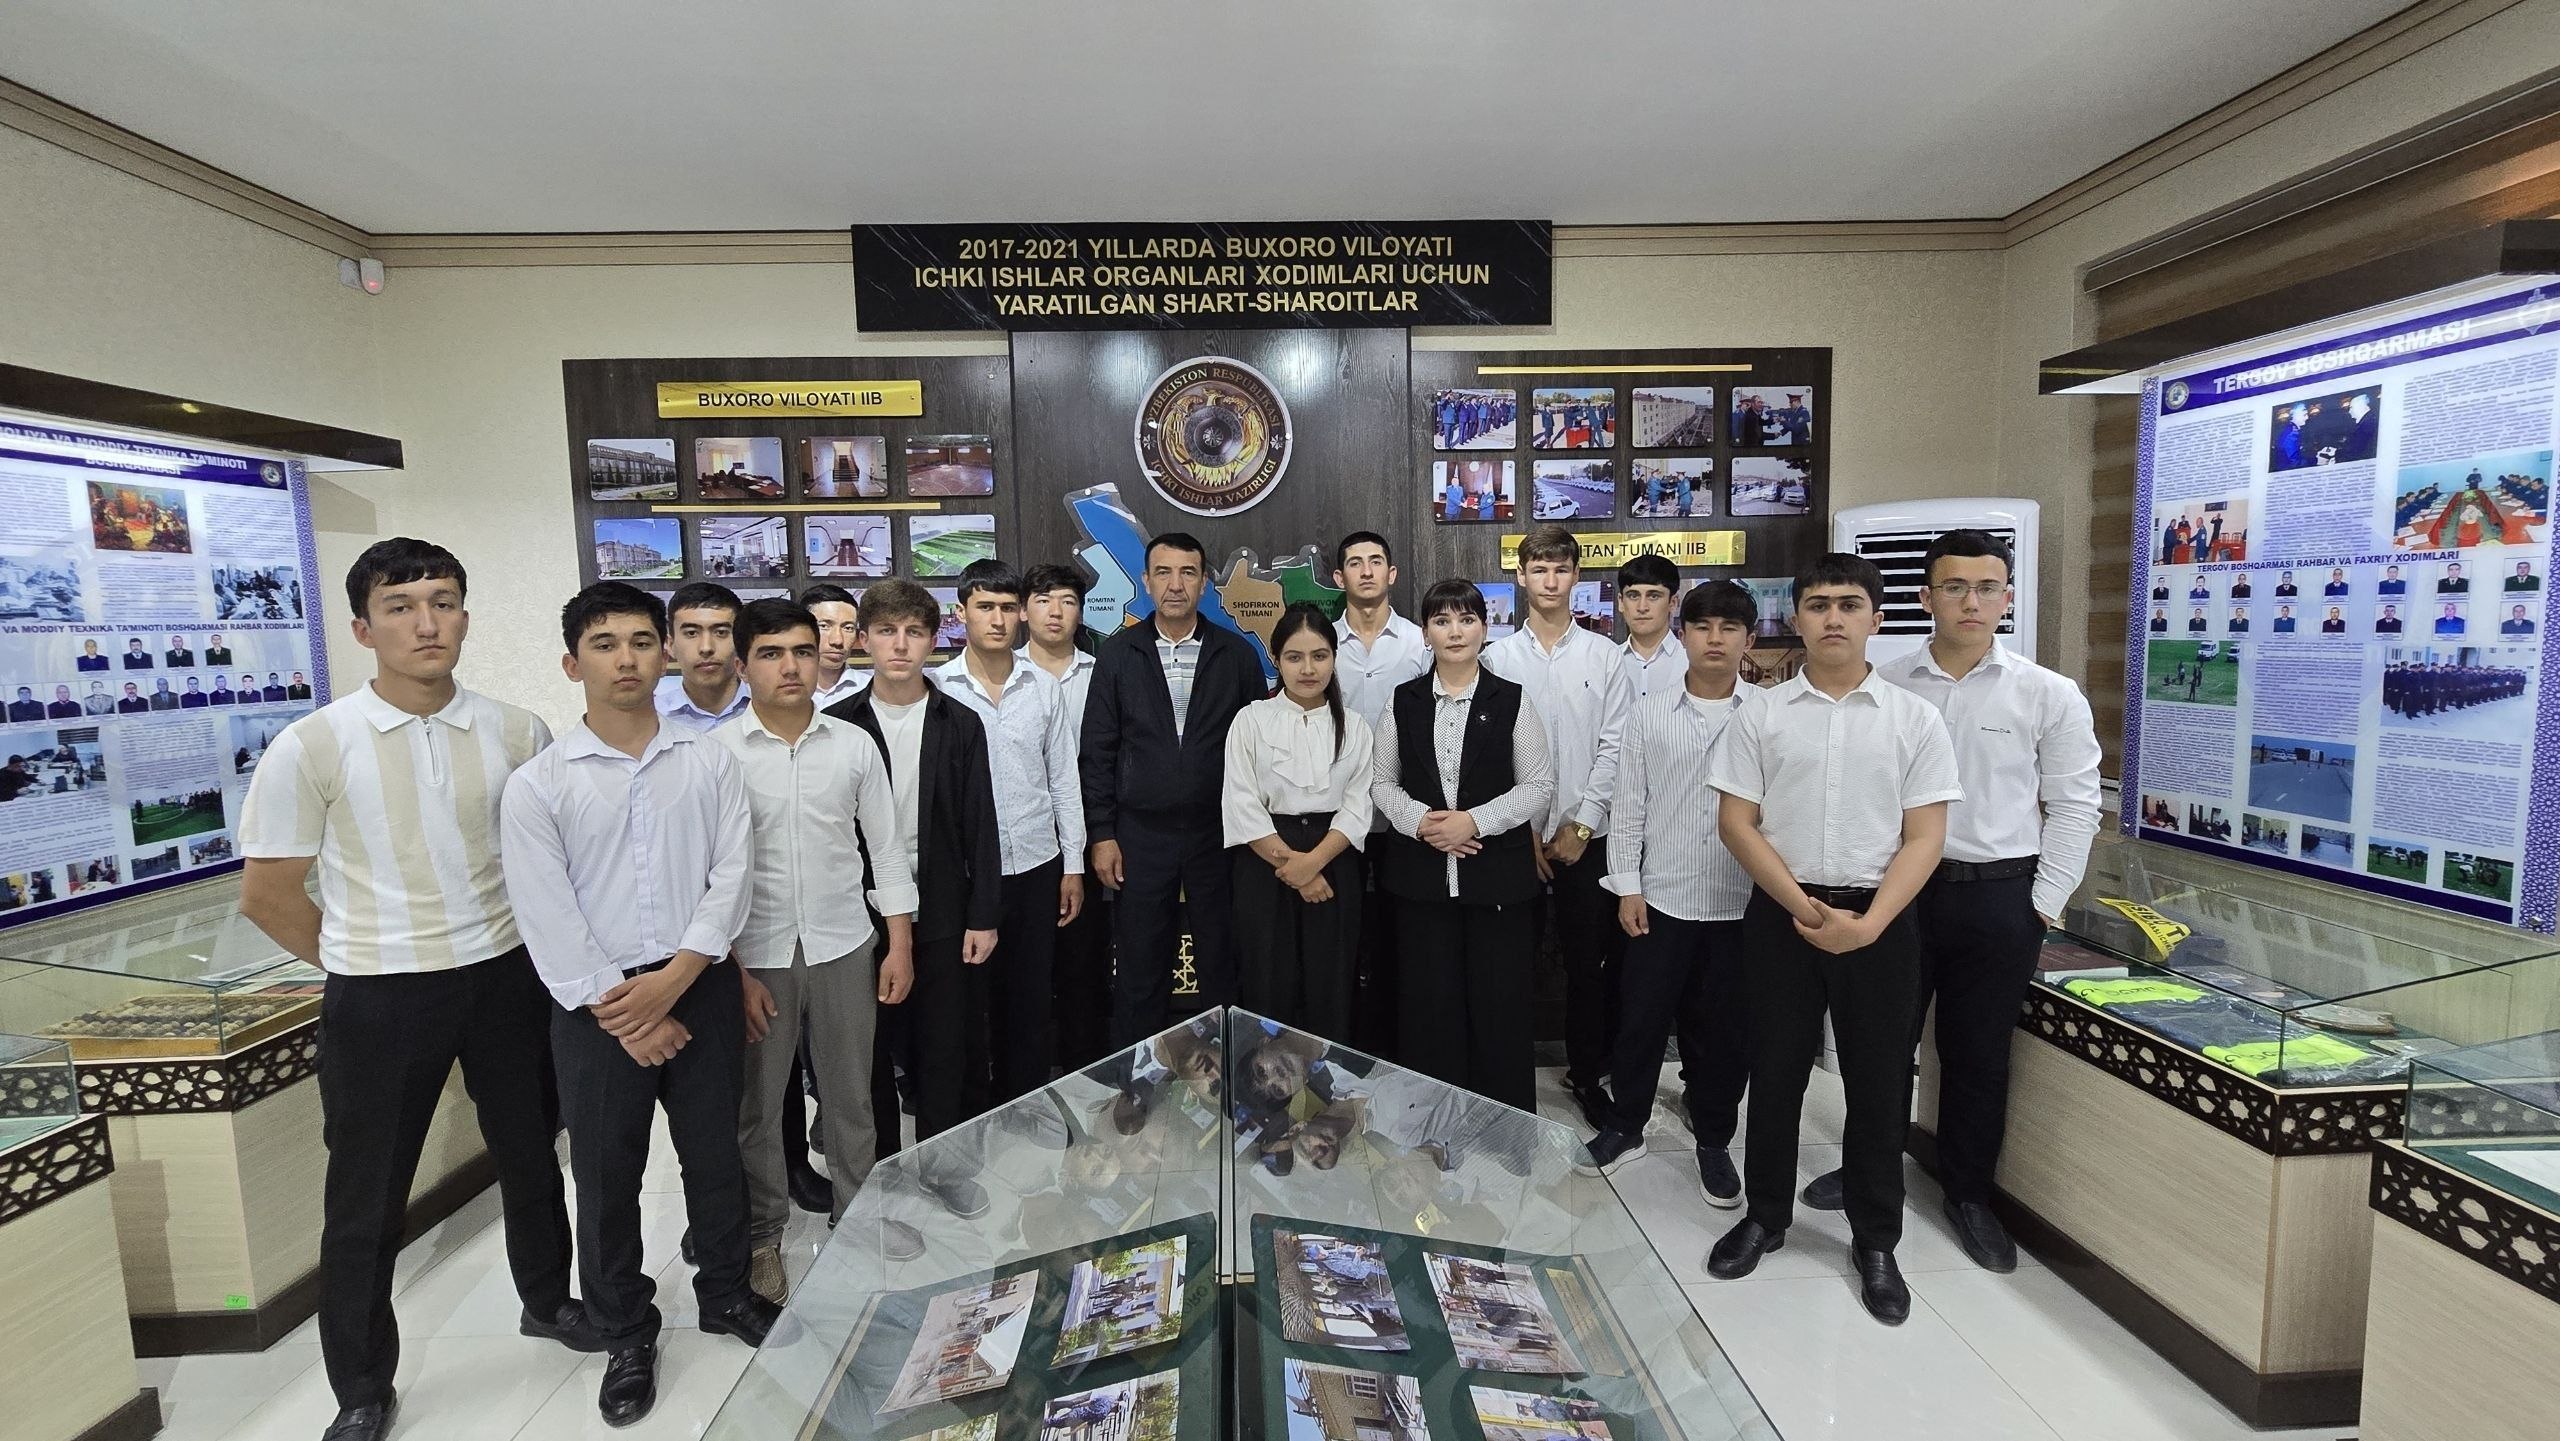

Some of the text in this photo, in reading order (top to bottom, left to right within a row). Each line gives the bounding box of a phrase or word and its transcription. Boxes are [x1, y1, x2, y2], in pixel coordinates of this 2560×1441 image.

[959, 236, 1453, 260] 2017-2021 YILLARDA BUXORO VILOYATI
[915, 264, 1490, 288] ICHKI ISHLAR ORGANLARI XODIMLARI UCHUN
[994, 291, 1419, 315] YARATILGAN SHART-SHAROITLAR
[2213, 319, 2472, 394] TERGOV BOSHQARMASI
[699, 391, 883, 407] BUXORO VILOYATI IIB
[1213, 368, 1281, 427] RESPUBLIKASI
[1179, 488, 1224, 506] ISHLAR
[1226, 460, 1277, 503] VAZIRLIGI
[1579, 541, 1706, 558] ITAN TUMANI IIB
[2197, 550, 2460, 573] TERGOV BOSHQARMASI RAHBAR VA FAXRIY XODIMLARI
[1232, 601, 1280, 609] SHOFIRKON
[2, 625, 20, 634] VA
[21, 625, 66, 634] MODDIY
[68, 624, 114, 633] TEXNIKA
[165, 623, 228, 632] BOSHQARMASI
